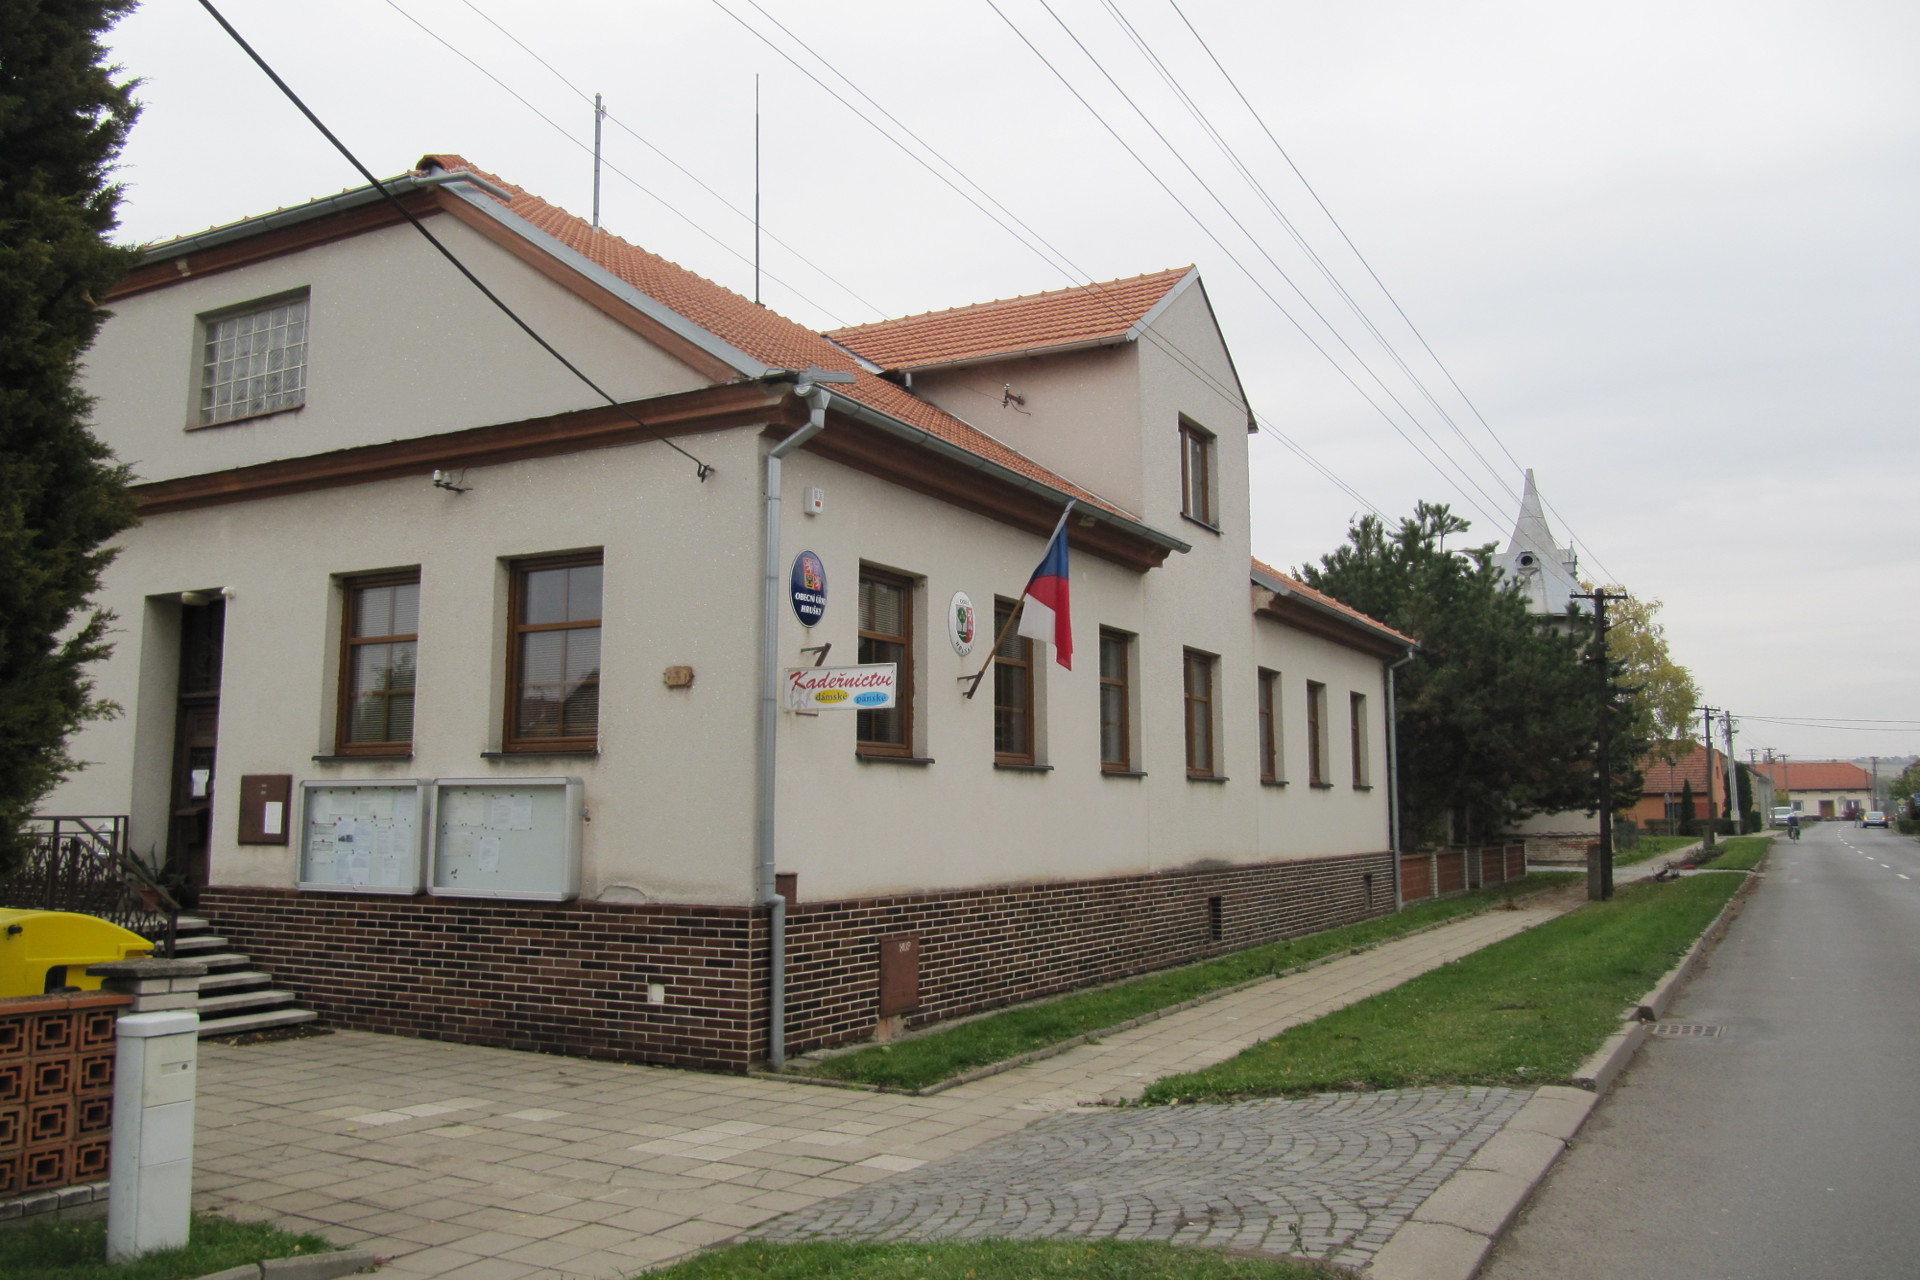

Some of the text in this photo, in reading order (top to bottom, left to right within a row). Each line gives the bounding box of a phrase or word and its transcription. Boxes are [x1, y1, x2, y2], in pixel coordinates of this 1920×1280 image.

[789, 670, 894, 691] Kadeřnictví
[815, 692, 887, 704] dámské pánské
